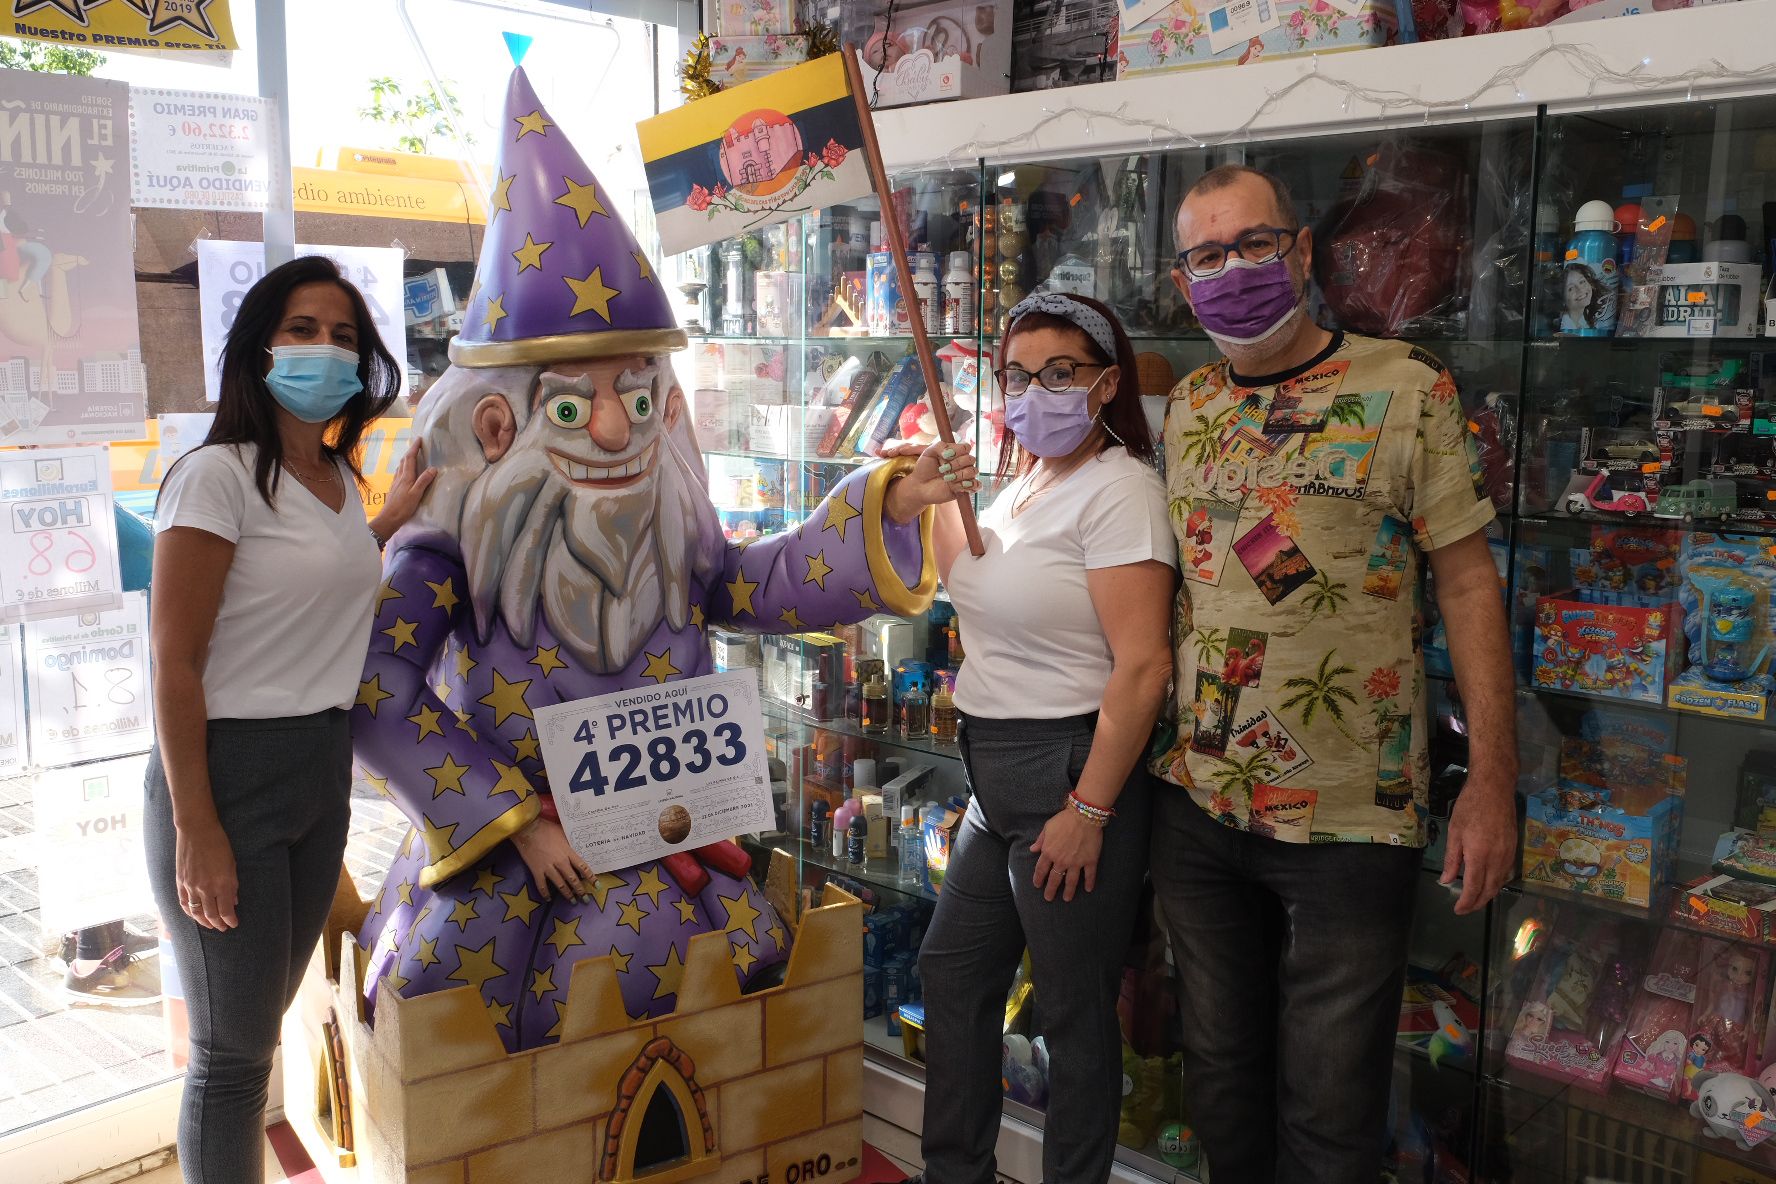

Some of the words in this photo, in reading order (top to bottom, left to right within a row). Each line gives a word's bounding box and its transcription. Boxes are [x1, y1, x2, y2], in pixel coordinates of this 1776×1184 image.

[164, 1, 192, 14] 2019
[14, 22, 87, 42] Nuestro
[91, 33, 160, 47] PREMIO
[292, 183, 329, 202] dio
[336, 188, 426, 210] ambiente
[1294, 369, 1341, 386] MEXICO
[614, 691, 662, 709] VENDIDO
[1674, 693, 1711, 707] FROZEN
[1727, 699, 1760, 712] FLASH
[572, 719, 599, 746] 4º
[605, 693, 729, 741] PREMIO
[1230, 710, 1268, 739] Trinidad
[568, 722, 748, 797] 42833
[1264, 800, 1309, 812] MEXICO
[621, 830, 646, 841] NAVIDAD
[1578, 815, 1626, 838] THINGS
